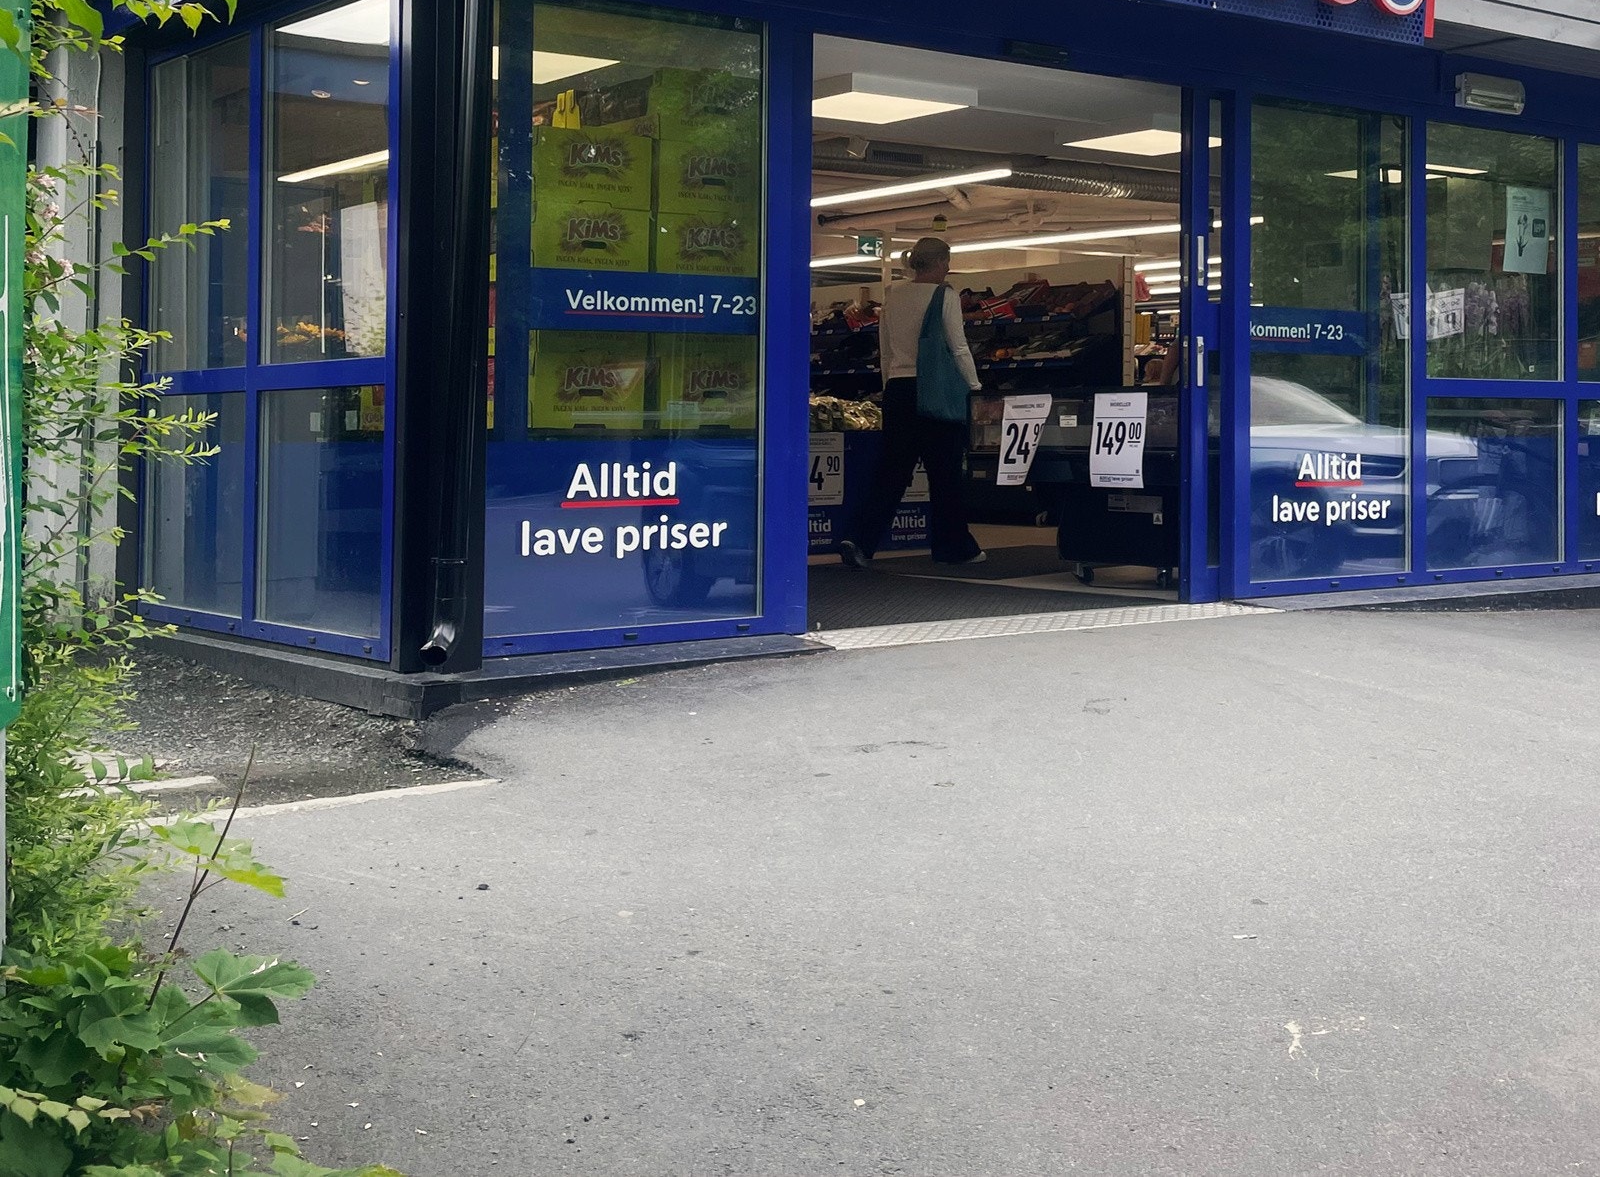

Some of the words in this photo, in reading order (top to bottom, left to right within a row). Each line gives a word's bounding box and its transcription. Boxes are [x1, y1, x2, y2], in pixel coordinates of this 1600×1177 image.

[565, 289, 705, 314] Velkommen!
[711, 295, 757, 315] 7-23
[1250, 322, 1311, 339] kommen!
[1314, 323, 1343, 341] 7-23
[1003, 422, 1030, 465] 24
[1095, 421, 1127, 456] 149
[1129, 422, 1142, 440] 00
[826, 455, 840, 473] 90
[1298, 452, 1362, 481] Alltid
[566, 461, 677, 500] Alltid
[891, 515, 926, 529] Alltid
[1272, 494, 1320, 522] lave
[1325, 493, 1391, 526] priser
[521, 519, 603, 557] lave
[616, 514, 728, 559] priser
[809, 518, 832, 533] ltid
